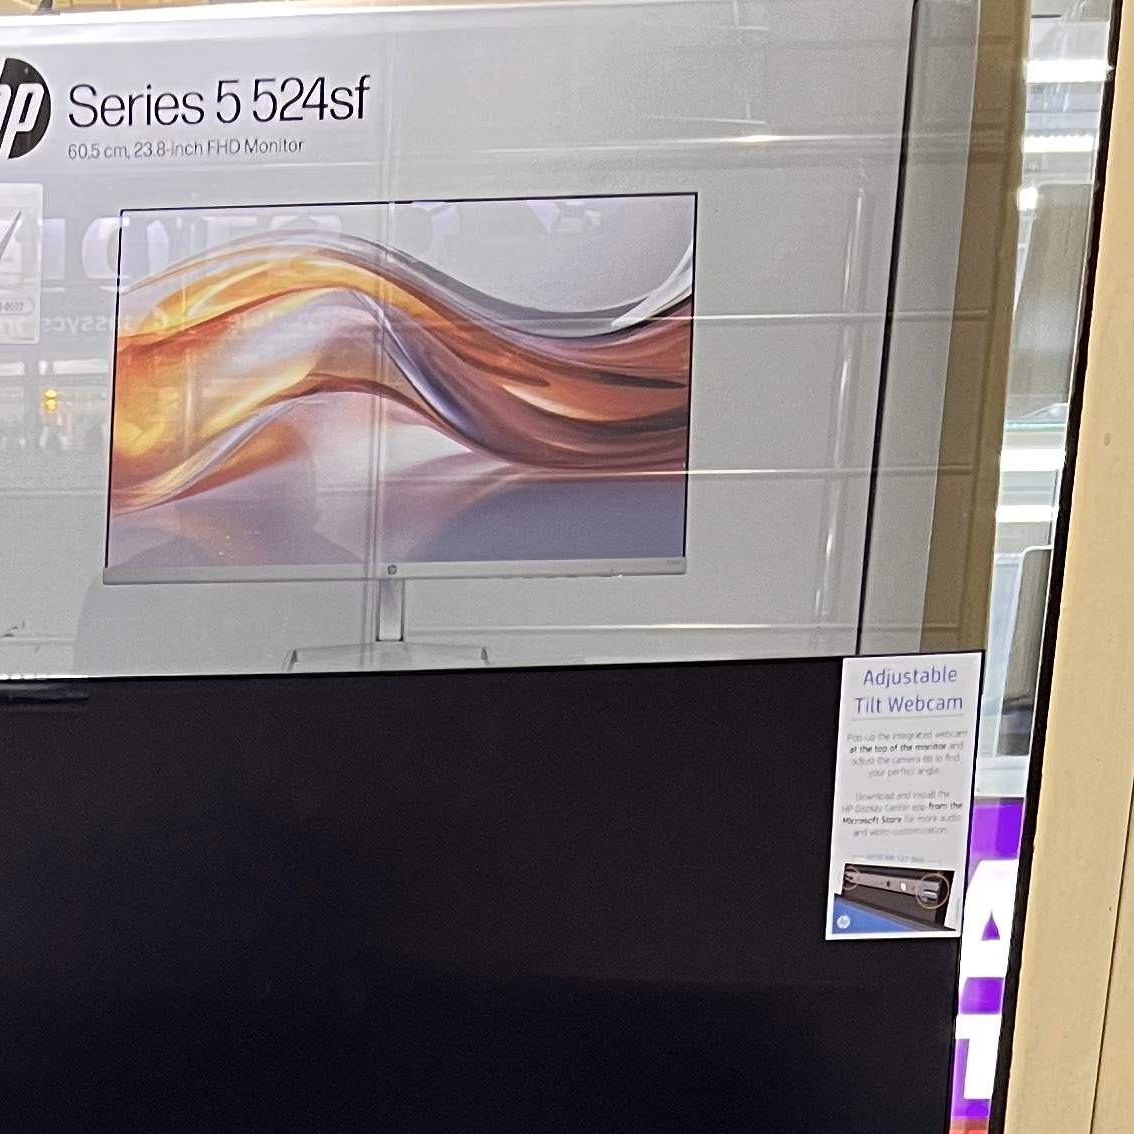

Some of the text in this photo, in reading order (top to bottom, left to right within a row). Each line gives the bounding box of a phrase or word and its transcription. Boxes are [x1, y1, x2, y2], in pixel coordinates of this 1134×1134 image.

[68, 74, 371, 128] Series 5 524sf
[207, 139, 241, 155] FHD
[244, 138, 304, 154] Monitor
[864, 666, 957, 689] Adjustable
[855, 695, 964, 714] Tilt Webcam
[849, 746, 857, 754] at
[860, 745, 872, 753] the
[874, 745, 888, 754] top
[890, 744, 898, 752] of
